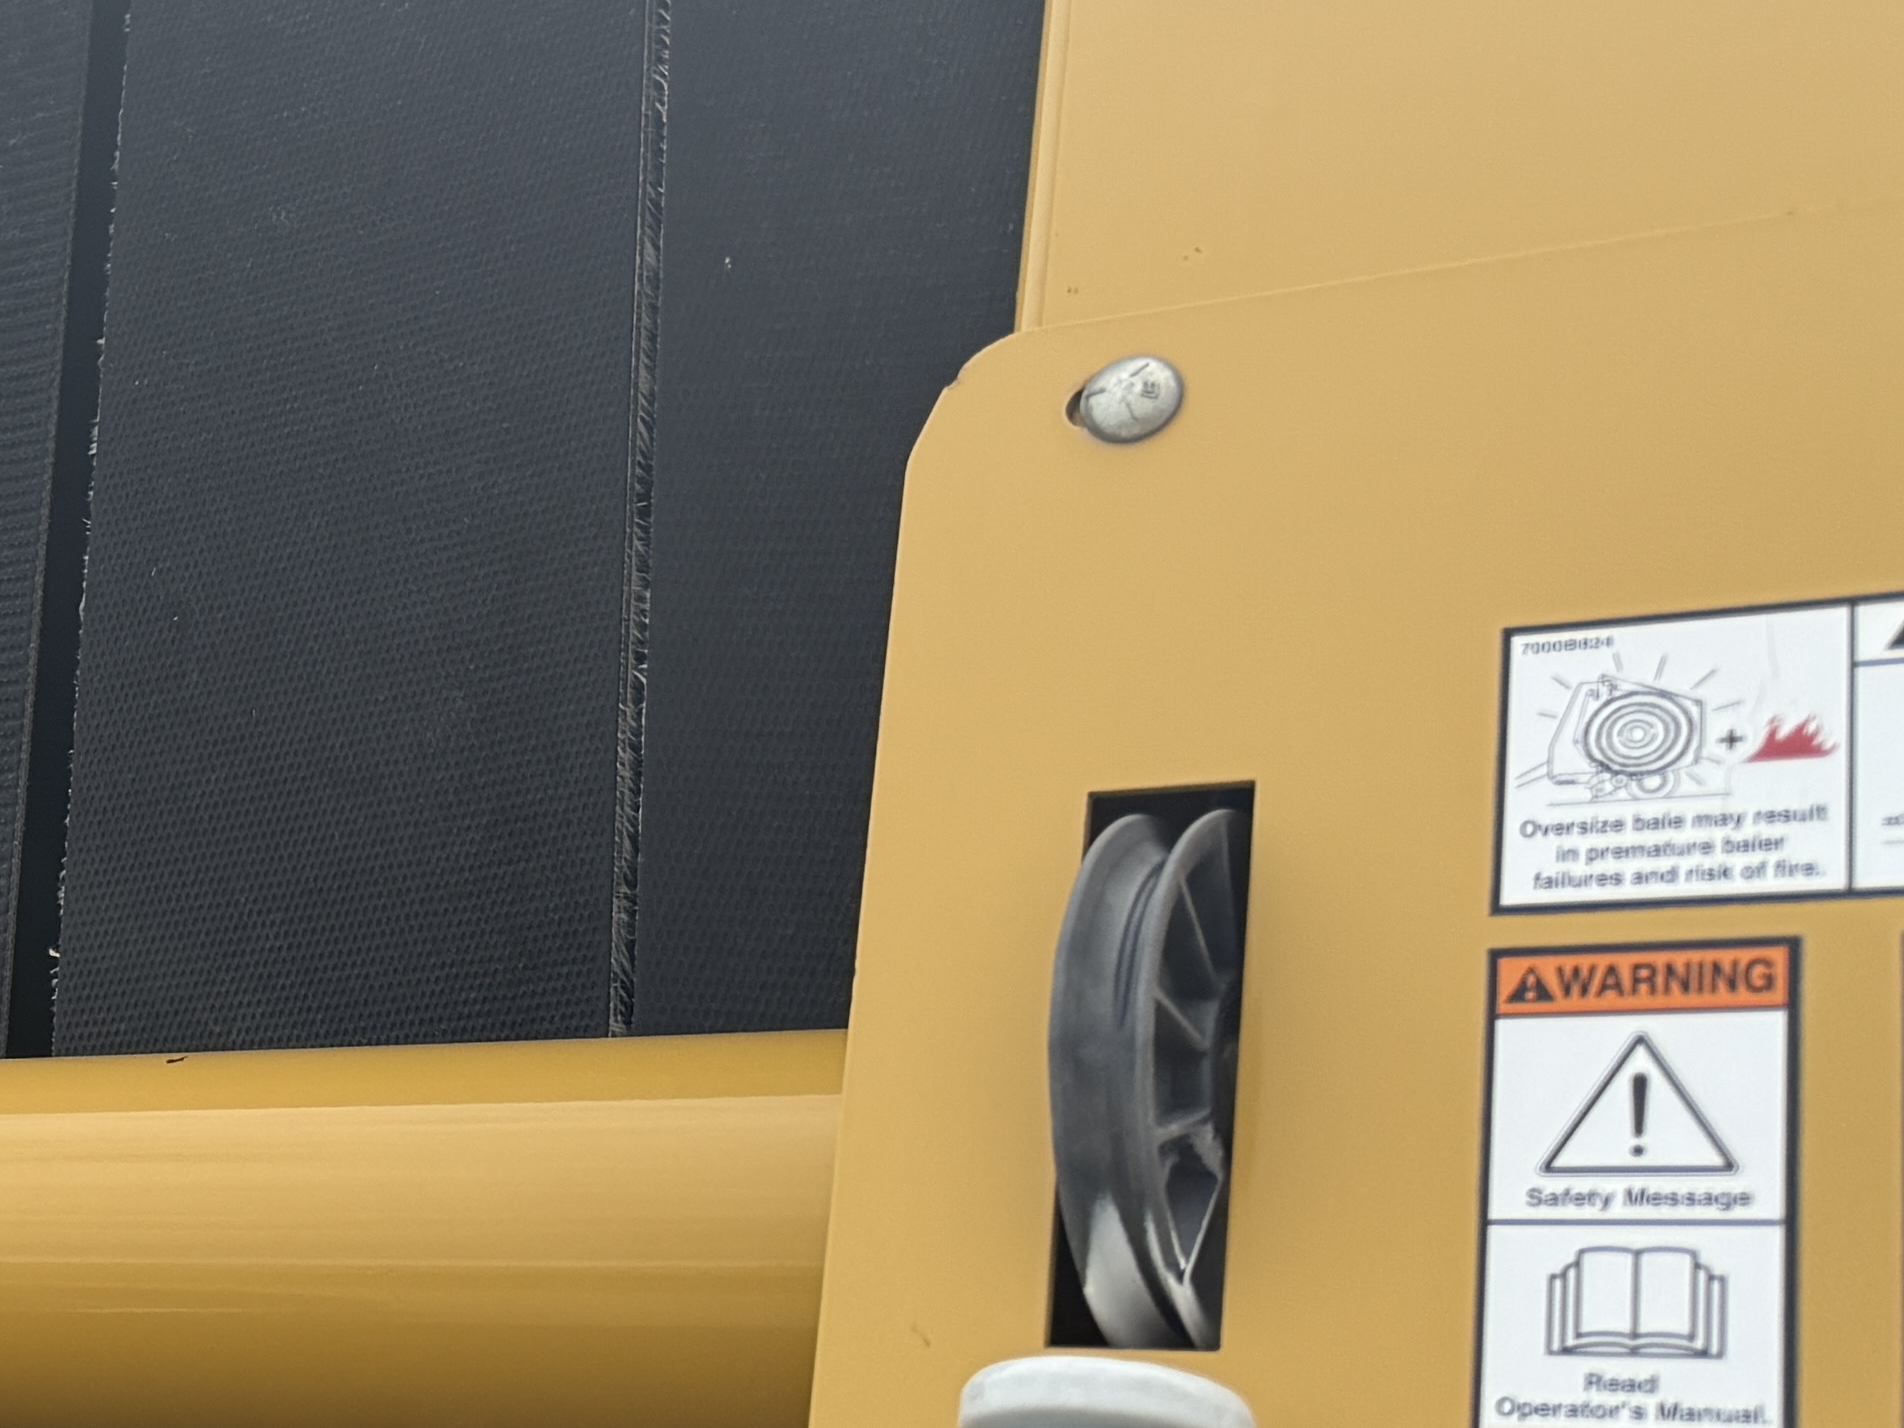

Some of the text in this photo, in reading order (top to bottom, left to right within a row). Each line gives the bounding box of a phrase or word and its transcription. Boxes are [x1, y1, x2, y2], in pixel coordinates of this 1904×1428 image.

[1519, 804, 1828, 838] Oversize bale may result
[1556, 836, 1784, 865] in premature baler
[1533, 858, 1824, 890] failures and risk of fire.
[1555, 958, 1775, 999] WARNING
[1525, 1187, 1753, 1211] Safety Message
[1583, 1372, 1660, 1393] Read
[1495, 1395, 1646, 1422] Operator's
